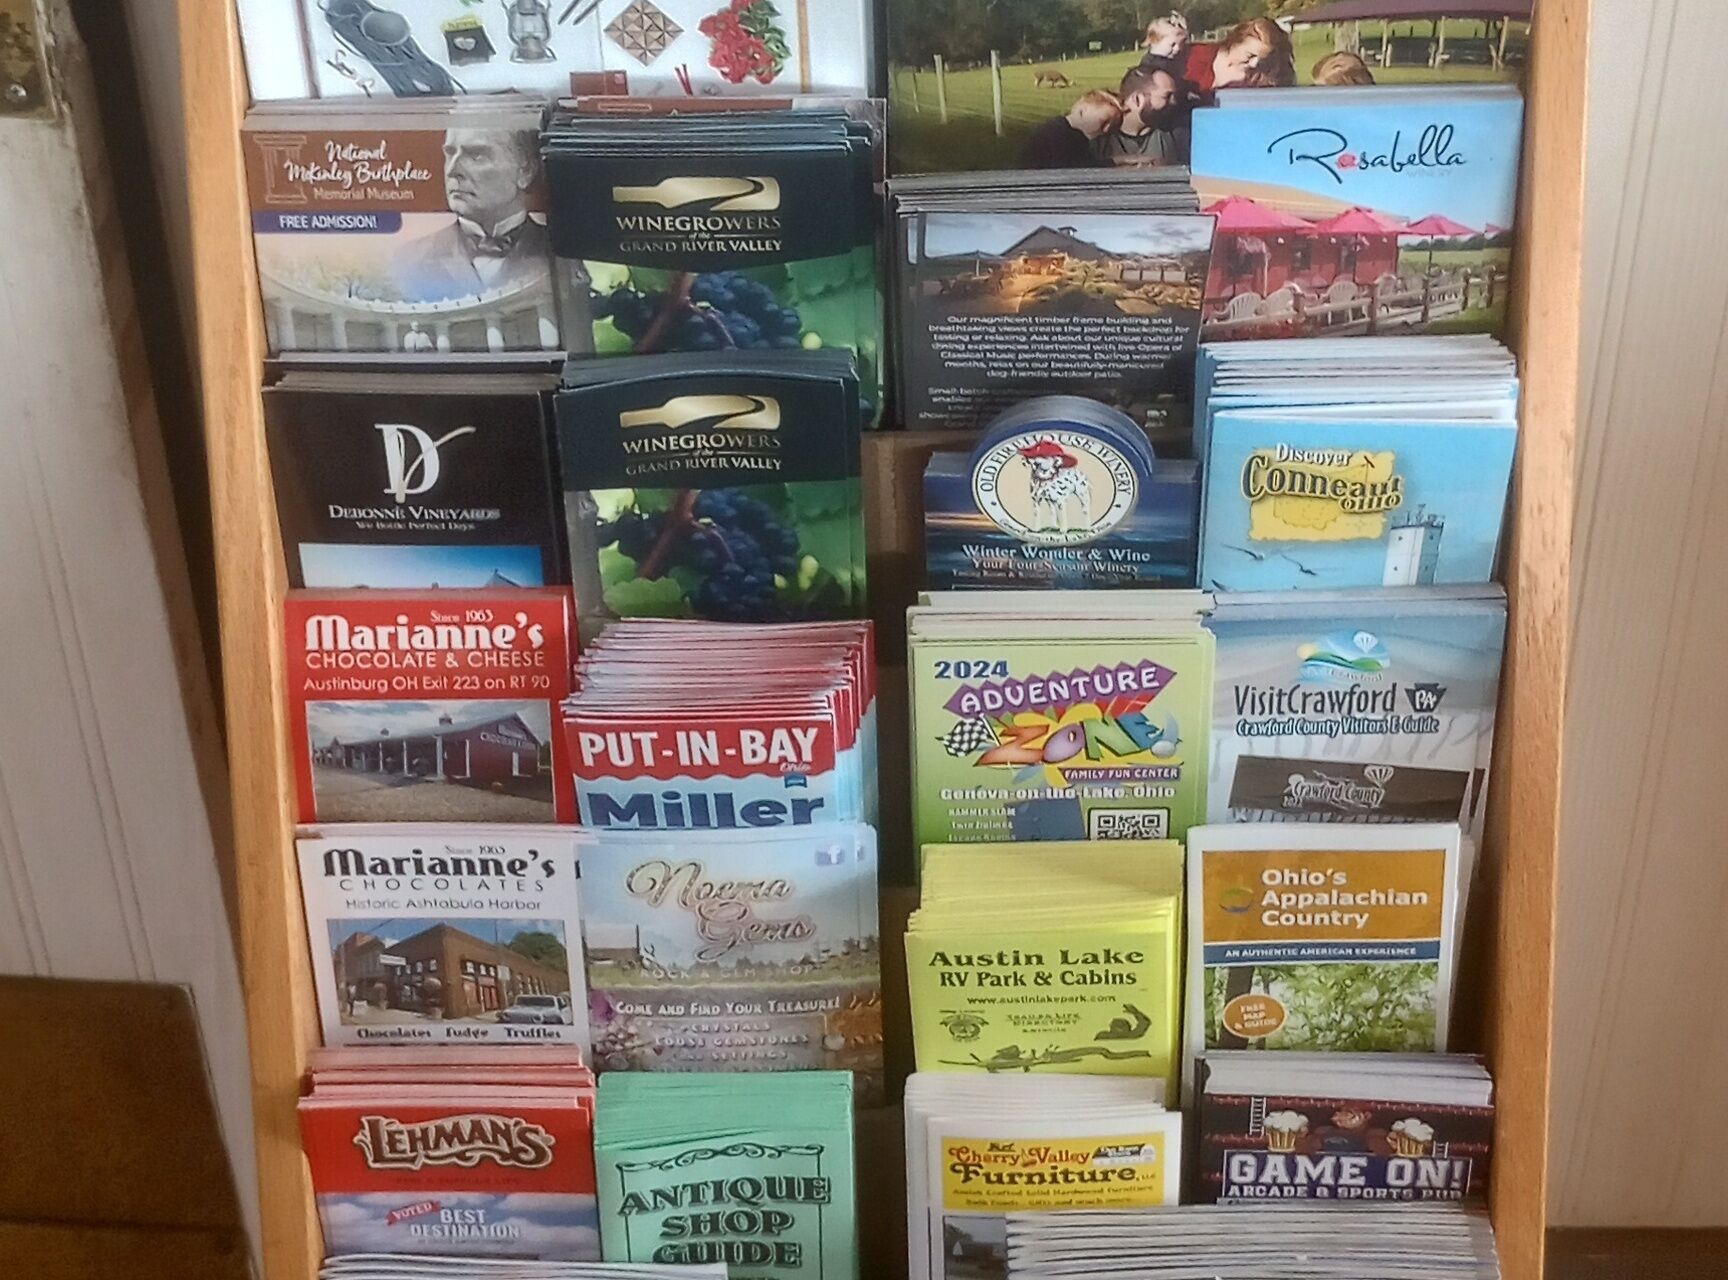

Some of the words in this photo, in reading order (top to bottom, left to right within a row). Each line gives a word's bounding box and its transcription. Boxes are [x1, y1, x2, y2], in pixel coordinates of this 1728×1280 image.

[325, 140, 387, 162] National
[1266, 123, 1467, 185] Rosabella
[284, 160, 352, 189] McKinley
[355, 160, 432, 187] Birthplace
[314, 187, 365, 201] Memorial
[366, 188, 415, 201] Museum
[279, 215, 309, 229] FREE
[311, 215, 378, 229] ADMISSION!
[616, 215, 782, 231] WINEGROWERS
[619, 240, 677, 252] GRAND
[681, 239, 727, 252] RIVER
[729, 239, 782, 252] VALLEY
[622, 433, 782, 455] WINEGROWERS
[1275, 442, 1354, 467] Discover
[625, 459, 681, 476] GRAND
[685, 457, 730, 471] RIVER
[730, 457, 783, 471] VALLEY
[1240, 453, 1403, 502] Conneaut
[961, 543, 1017, 559] Winter
[1021, 545, 1085, 561] Wonder
[1087, 548, 1103, 561] &
[1107, 548, 1151, 562] Wine
[465, 609, 493, 622] 1963
[305, 611, 545, 651] Marianne's
[306, 651, 437, 669] CHOCOLATE
[445, 651, 459, 668] &
[467, 650, 545, 668] CHEESE
[933, 660, 1010, 680] 2024
[304, 676, 388, 693] Austinburg
[392, 676, 419, 691] OH
[422, 676, 448, 690] Exit
[453, 676, 480, 690] 223
[484, 678, 506, 689] on
[510, 676, 526, 689] RT
[531, 676, 550, 689] 90
[960, 666, 1161, 715] ADVENTURE
[1234, 683, 1398, 716] VisitCrawford
[1414, 689, 1438, 710] PA
[1236, 718, 1296, 736] Crawford
[1296, 718, 1341, 738] County
[1402, 716, 1440, 734] Guide
[578, 727, 819, 768] PUT-IN-BAY
[973, 711, 1167, 767] ZONE
[1064, 769, 1105, 780] FAMILY
[1108, 769, 1130, 780] FUN
[1134, 768, 1179, 779] CENTER
[1133, 785, 1176, 798] Ohio
[1293, 779, 1345, 802] Crawford
[1344, 782, 1386, 808] County
[586, 790, 825, 831] Miller
[323, 848, 557, 879] Marianne's
[339, 878, 545, 892] CHOCOLATES
[1261, 868, 1347, 886] Ohio's
[345, 898, 400, 910] Historic
[405, 898, 485, 910] Ashtabula
[488, 899, 541, 911] Harbor
[1261, 887, 1429, 908] Appalachian
[1261, 909, 1370, 929] Country
[695, 899, 816, 961] Gems
[928, 949, 1045, 967] Austin
[1059, 948, 1145, 966] Lake
[1225, 949, 1240, 957] AN
[1241, 947, 1299, 957] AUTHENTIC
[1300, 947, 1353, 957] AMERICAN
[1354, 946, 1417, 956] EXPERIENCE
[940, 971, 970, 987] RV
[976, 970, 1027, 987] Park
[1033, 970, 1053, 986] &
[1060, 969, 1138, 986] Cabins
[966, 994, 1117, 1006] www.austinlakepark.com
[356, 1026, 432, 1039] Chocolates
[445, 1026, 489, 1040] Fudge
[503, 1026, 561, 1039] Truffles
[354, 1114, 556, 1170] LEHMAN'S
[948, 1146, 1021, 1167] Cherry
[1029, 1145, 1091, 1166] Valley
[1228, 1153, 1369, 1186] GAME
[1385, 1157, 1465, 1190] ON!
[617, 1176, 833, 1218] ANTIQUE
[1228, 1185, 1308, 1199] ARCADE
[1315, 1186, 1330, 1199] &
[1337, 1186, 1414, 1200] SPORTS
[1421, 1189, 1462, 1200] PUB
[391, 1201, 433, 1220] VOTED
[440, 1208, 487, 1224] BEST
[410, 1224, 520, 1239] DESTINATION
[659, 1210, 796, 1239] SHOP
[652, 1241, 803, 1269] GUIDE
